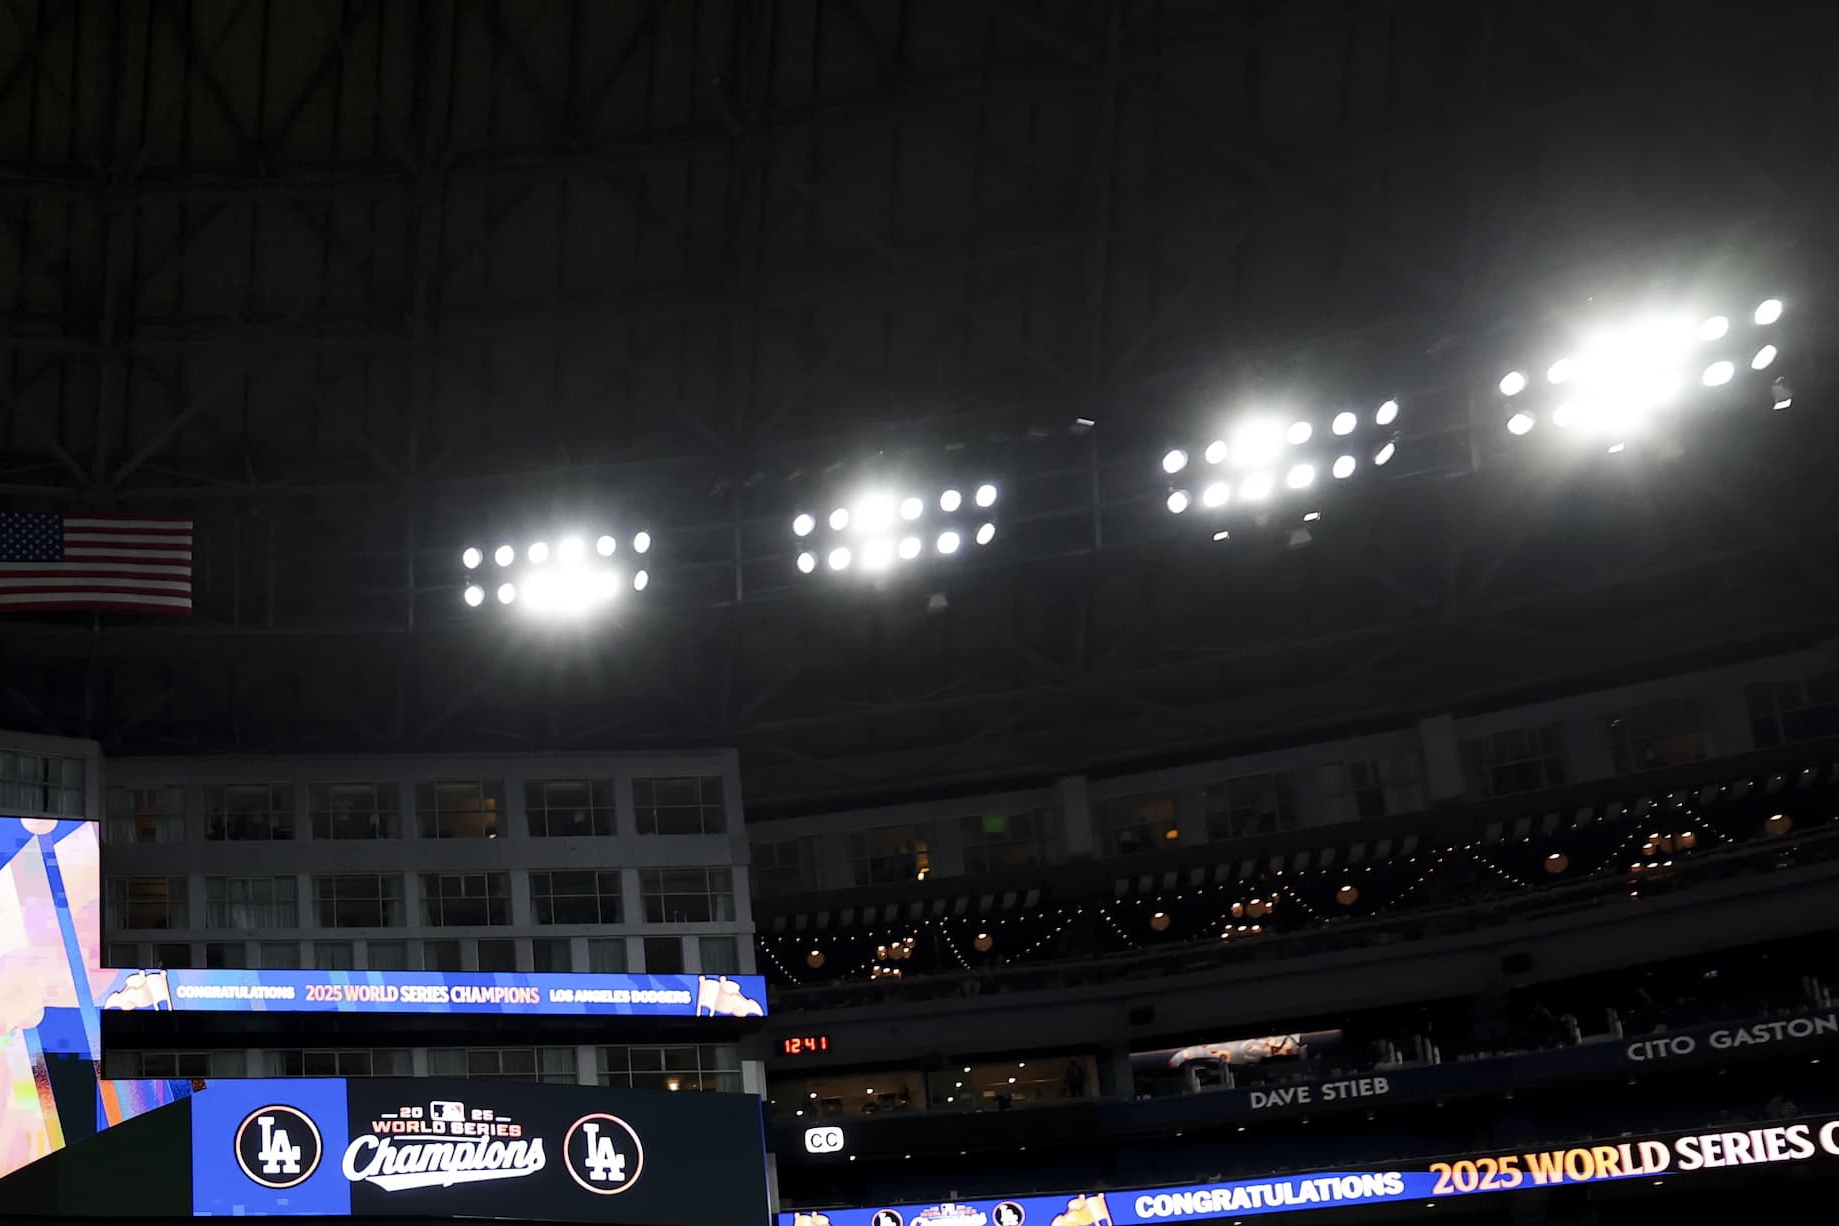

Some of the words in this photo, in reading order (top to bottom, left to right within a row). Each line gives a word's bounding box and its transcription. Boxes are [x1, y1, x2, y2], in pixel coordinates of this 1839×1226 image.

[176, 986, 295, 1000] CONGRATULATIONS
[305, 984, 343, 1002] 2025
[343, 985, 399, 1003] WORLD
[399, 986, 450, 1004] SERIES
[450, 986, 540, 1004] CHAMPIONS
[549, 989, 574, 1003] LOS
[574, 990, 630, 1003] ANGELES
[630, 990, 692, 1004] DODGERS
[1627, 1036, 1695, 1061] CITO
[1709, 1013, 1839, 1049] GASTON
[1250, 1086, 1312, 1109] DAVE
[1322, 1077, 1390, 1101] STIEB
[372, 1121, 445, 1134] WORLD
[450, 1122, 521, 1137] SERIES
[399, 1107, 423, 1118] 20
[471, 1110, 494, 1121] 25
[257, 1116, 301, 1174] LA
[582, 1123, 625, 1181] LA
[810, 1132, 838, 1149] CC
[342, 1135, 546, 1191] Champions
[1429, 1156, 1523, 1195] 2025
[1524, 1140, 1670, 1184] WORLD
[1675, 1125, 1815, 1170] SERIES
[1135, 1172, 1404, 1218] CONGRATULATIONS
